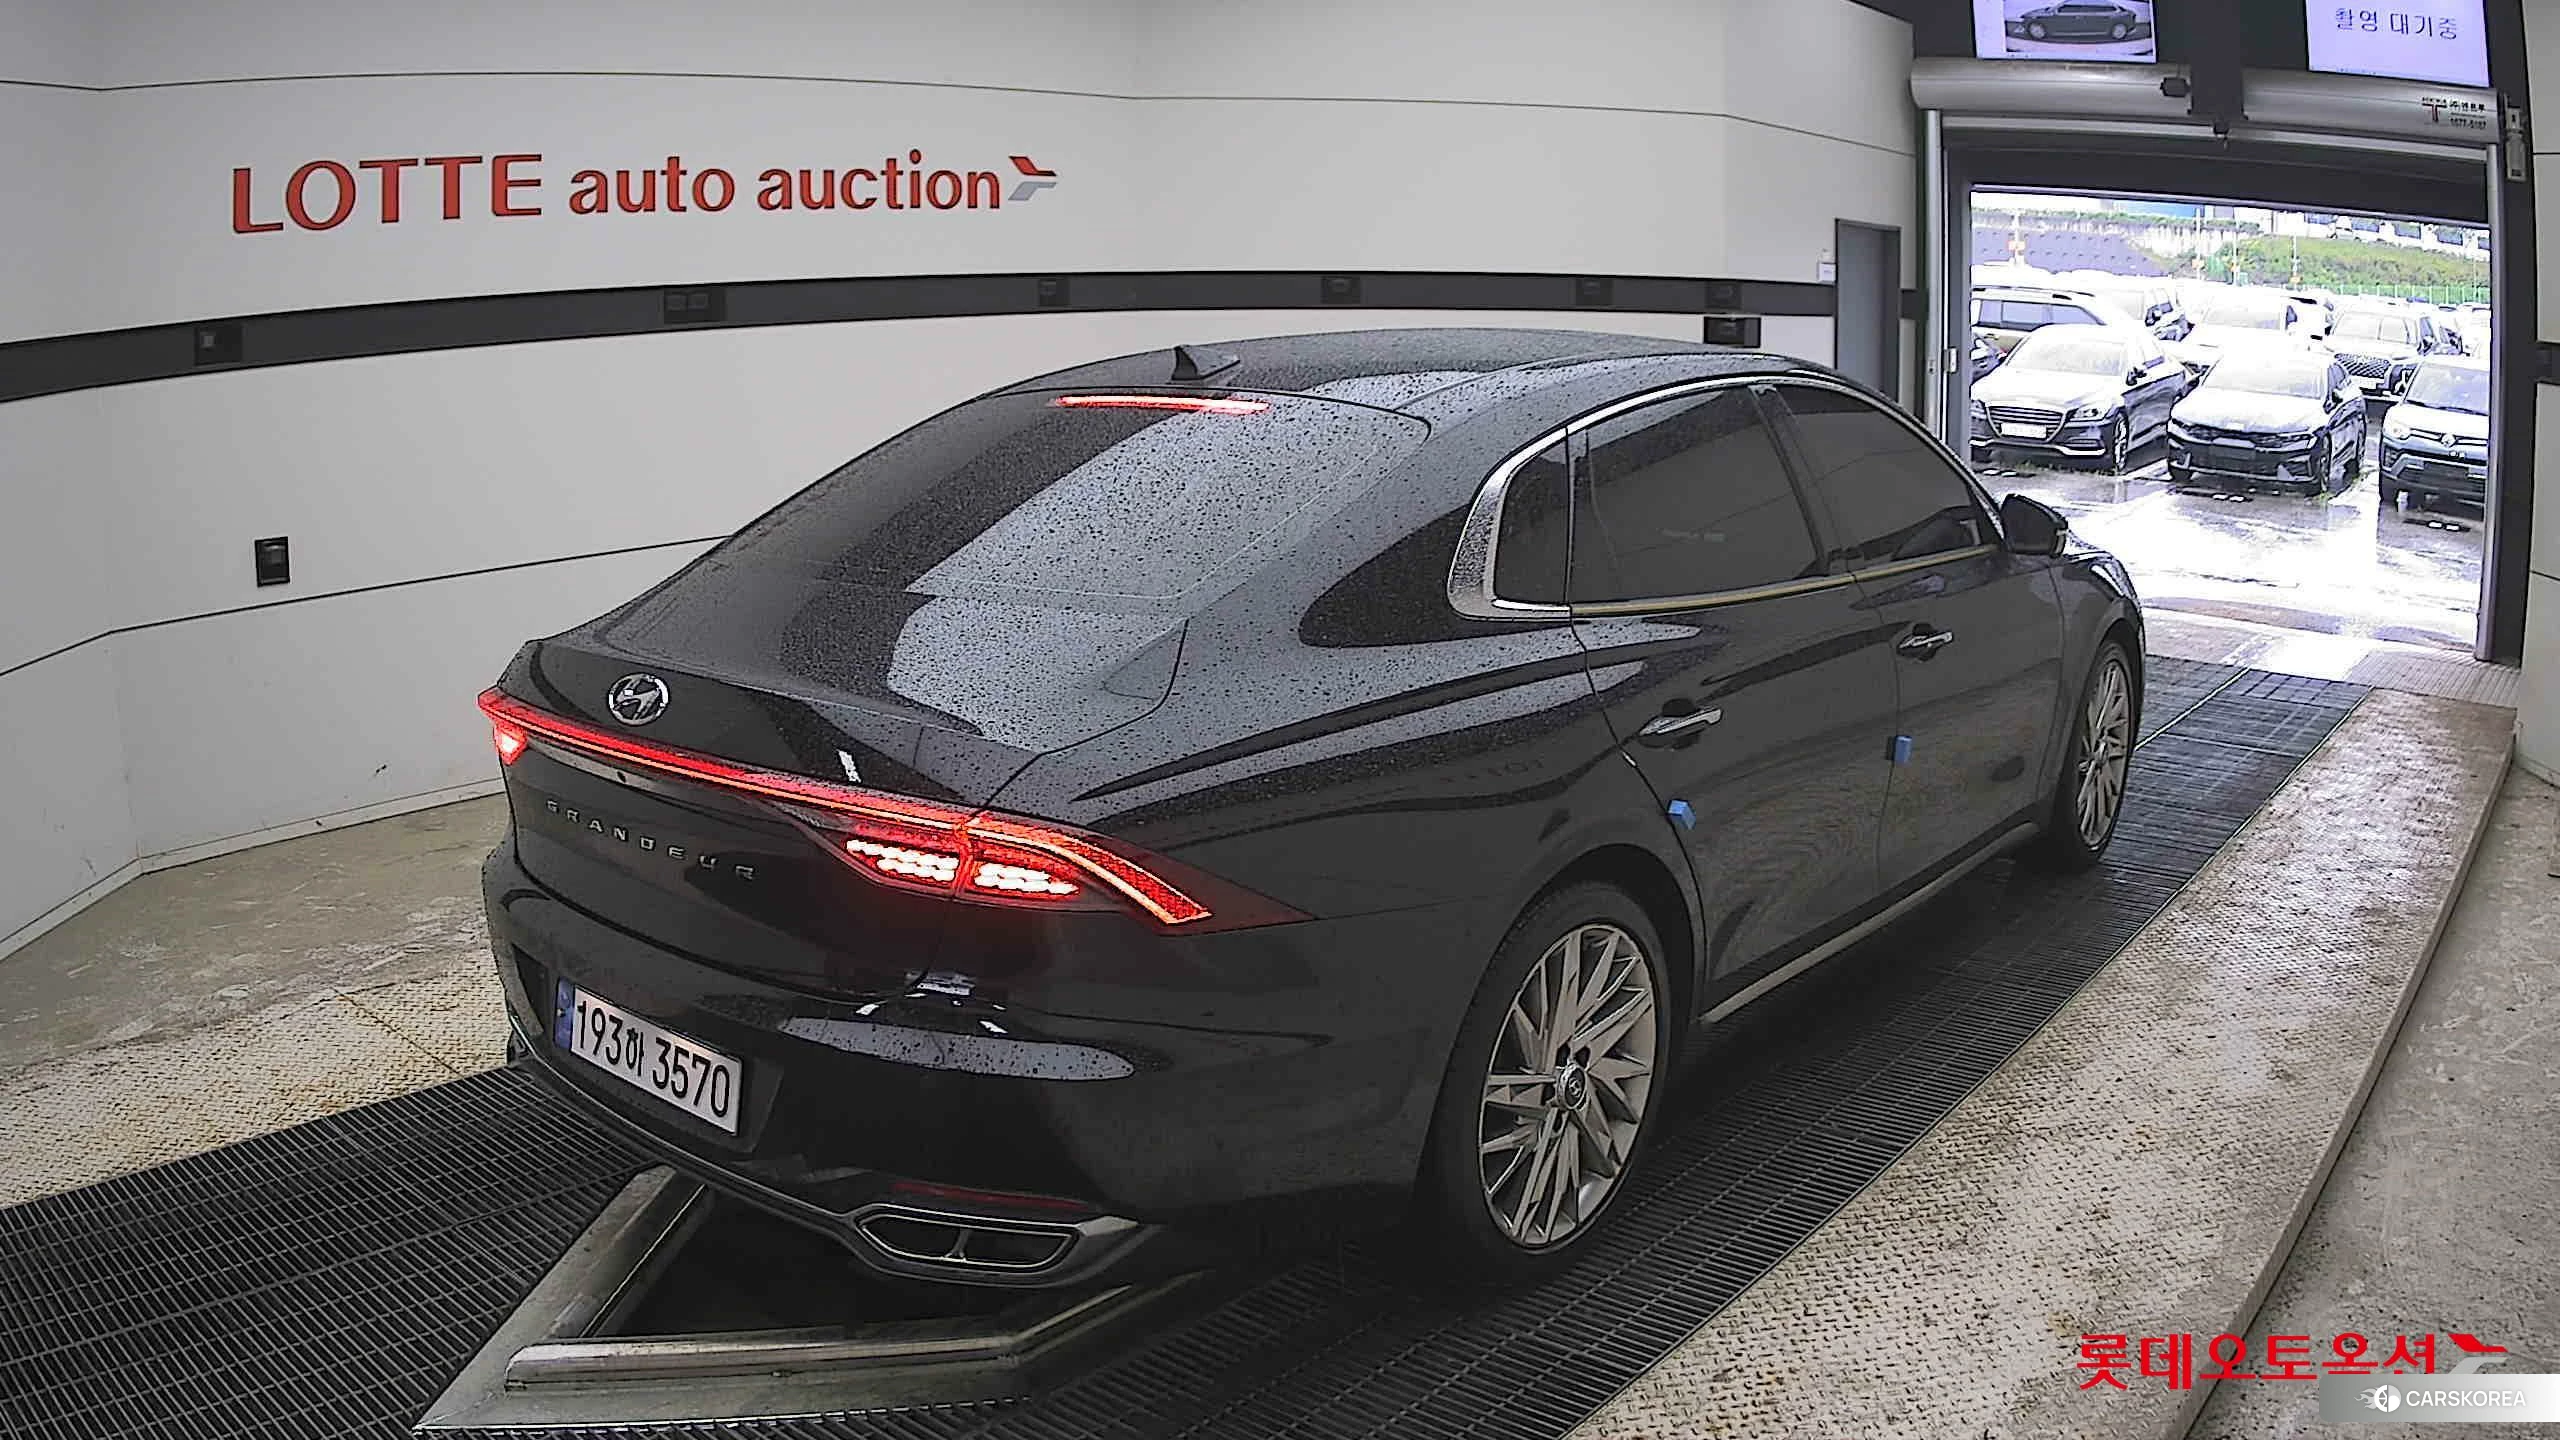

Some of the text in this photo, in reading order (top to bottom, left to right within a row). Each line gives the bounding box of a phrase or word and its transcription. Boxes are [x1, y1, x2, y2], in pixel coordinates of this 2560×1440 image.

[2335, 7, 2379, 33] 촬영
[232, 148, 1001, 234] LOTTE auto auction
[545, 799, 756, 882] GRANDEUR
[576, 1000, 731, 1118] 193하 3570
